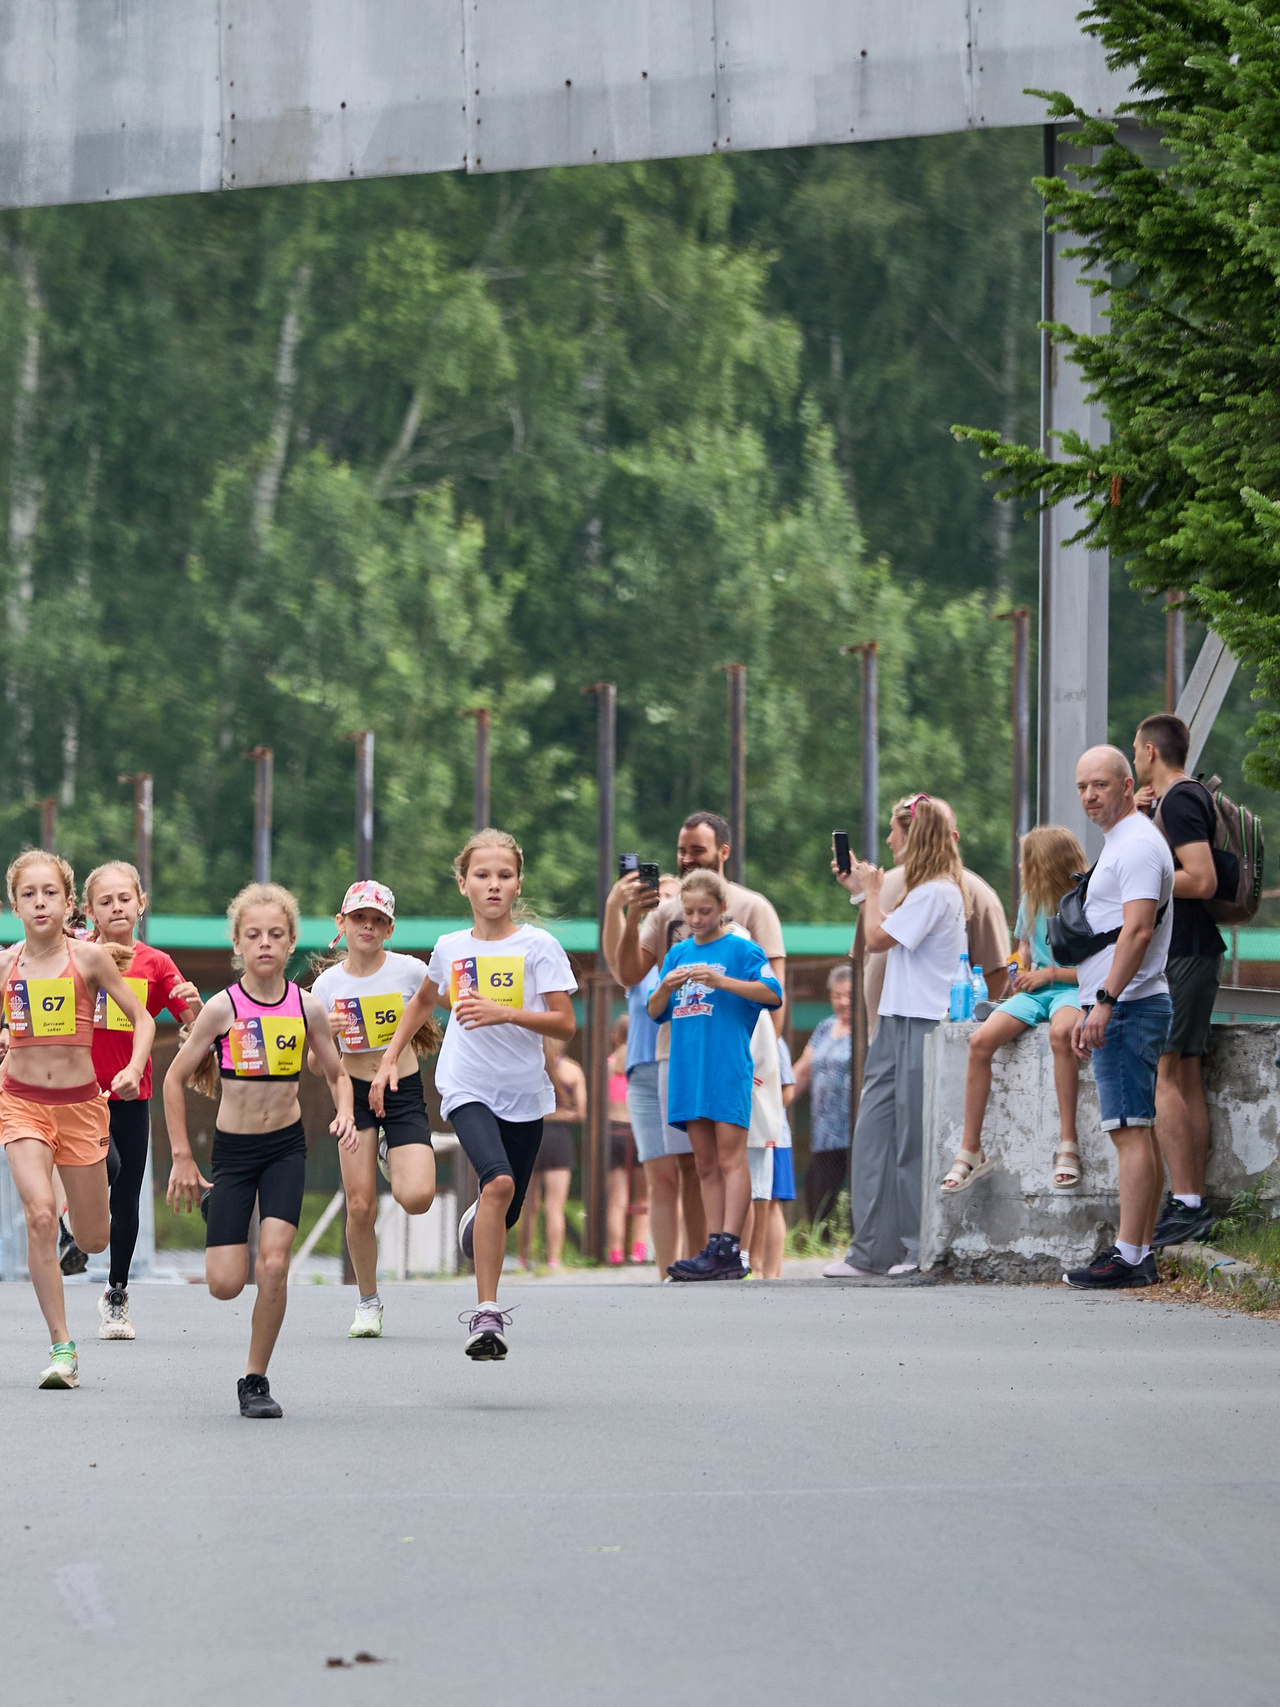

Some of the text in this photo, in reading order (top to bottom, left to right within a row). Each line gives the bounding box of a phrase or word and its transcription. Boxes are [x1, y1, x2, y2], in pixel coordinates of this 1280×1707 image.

[490, 972, 514, 988] 63
[41, 996, 66, 1012] 67
[374, 1009, 397, 1025] 56
[276, 1035, 297, 1051] 64
